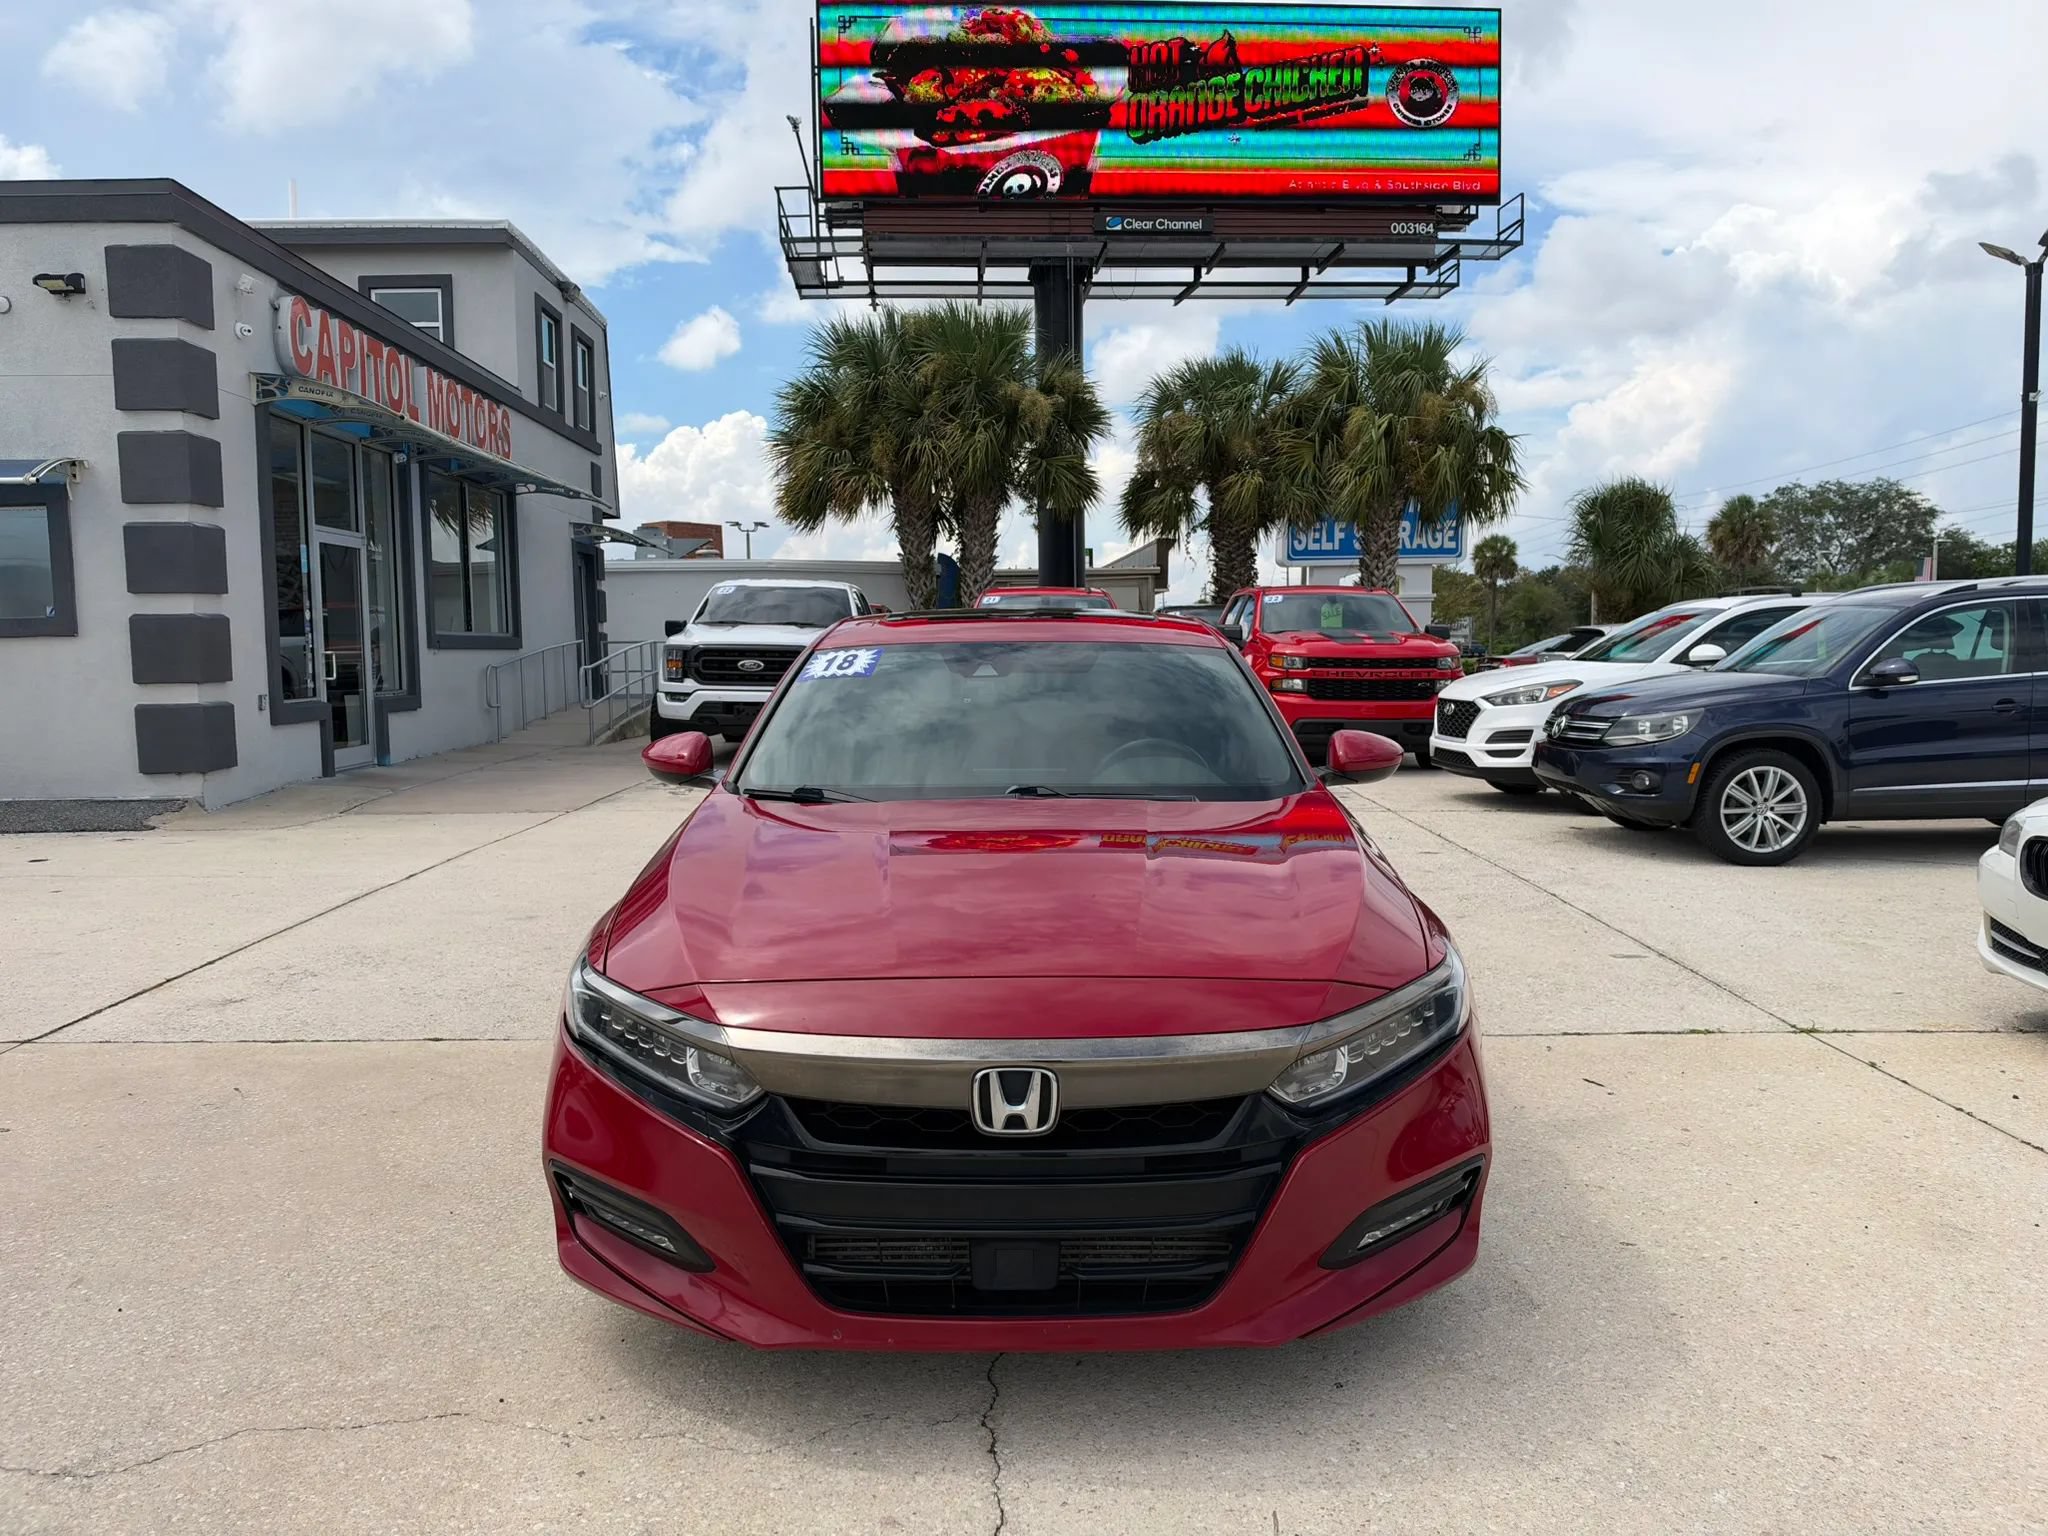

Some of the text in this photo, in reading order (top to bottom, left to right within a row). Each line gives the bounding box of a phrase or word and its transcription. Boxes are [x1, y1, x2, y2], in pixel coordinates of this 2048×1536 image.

[1128, 72, 1241, 138] ORANGE
[1244, 46, 1365, 111] CHICKEN
[1452, 180, 1481, 190] Blvd
[1123, 218, 1203, 230] Clear Channel
[1390, 222, 1435, 234] 003164
[290, 295, 513, 461] CAPITOL MOTORS
[1293, 520, 1457, 551] SELF SRAGE
[822, 653, 859, 672] 18
[1312, 670, 1434, 679] CHEVROLET
